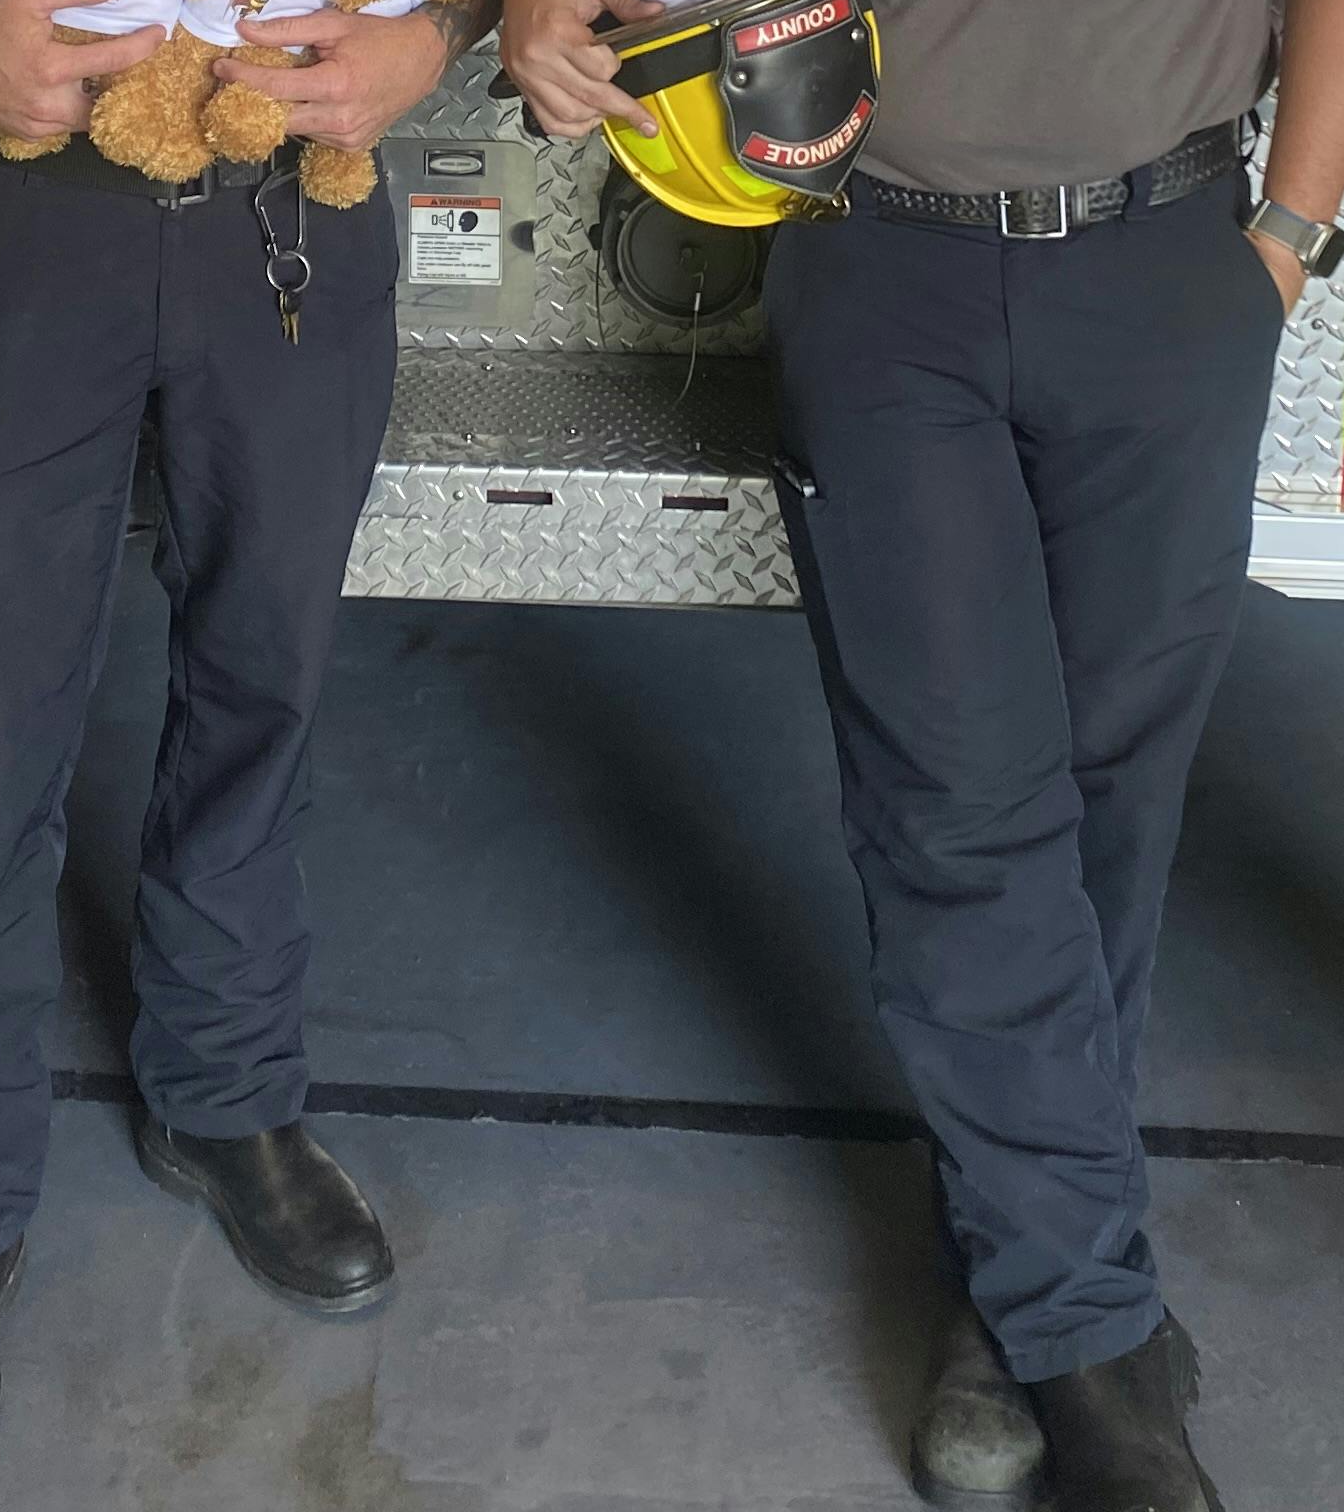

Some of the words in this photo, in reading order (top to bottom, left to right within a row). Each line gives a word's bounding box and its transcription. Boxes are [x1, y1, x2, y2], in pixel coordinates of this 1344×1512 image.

[757, 3, 836, 46] COUNTY
[763, 112, 862, 165] SEMINOLE
[439, 199, 482, 207] WARNING
